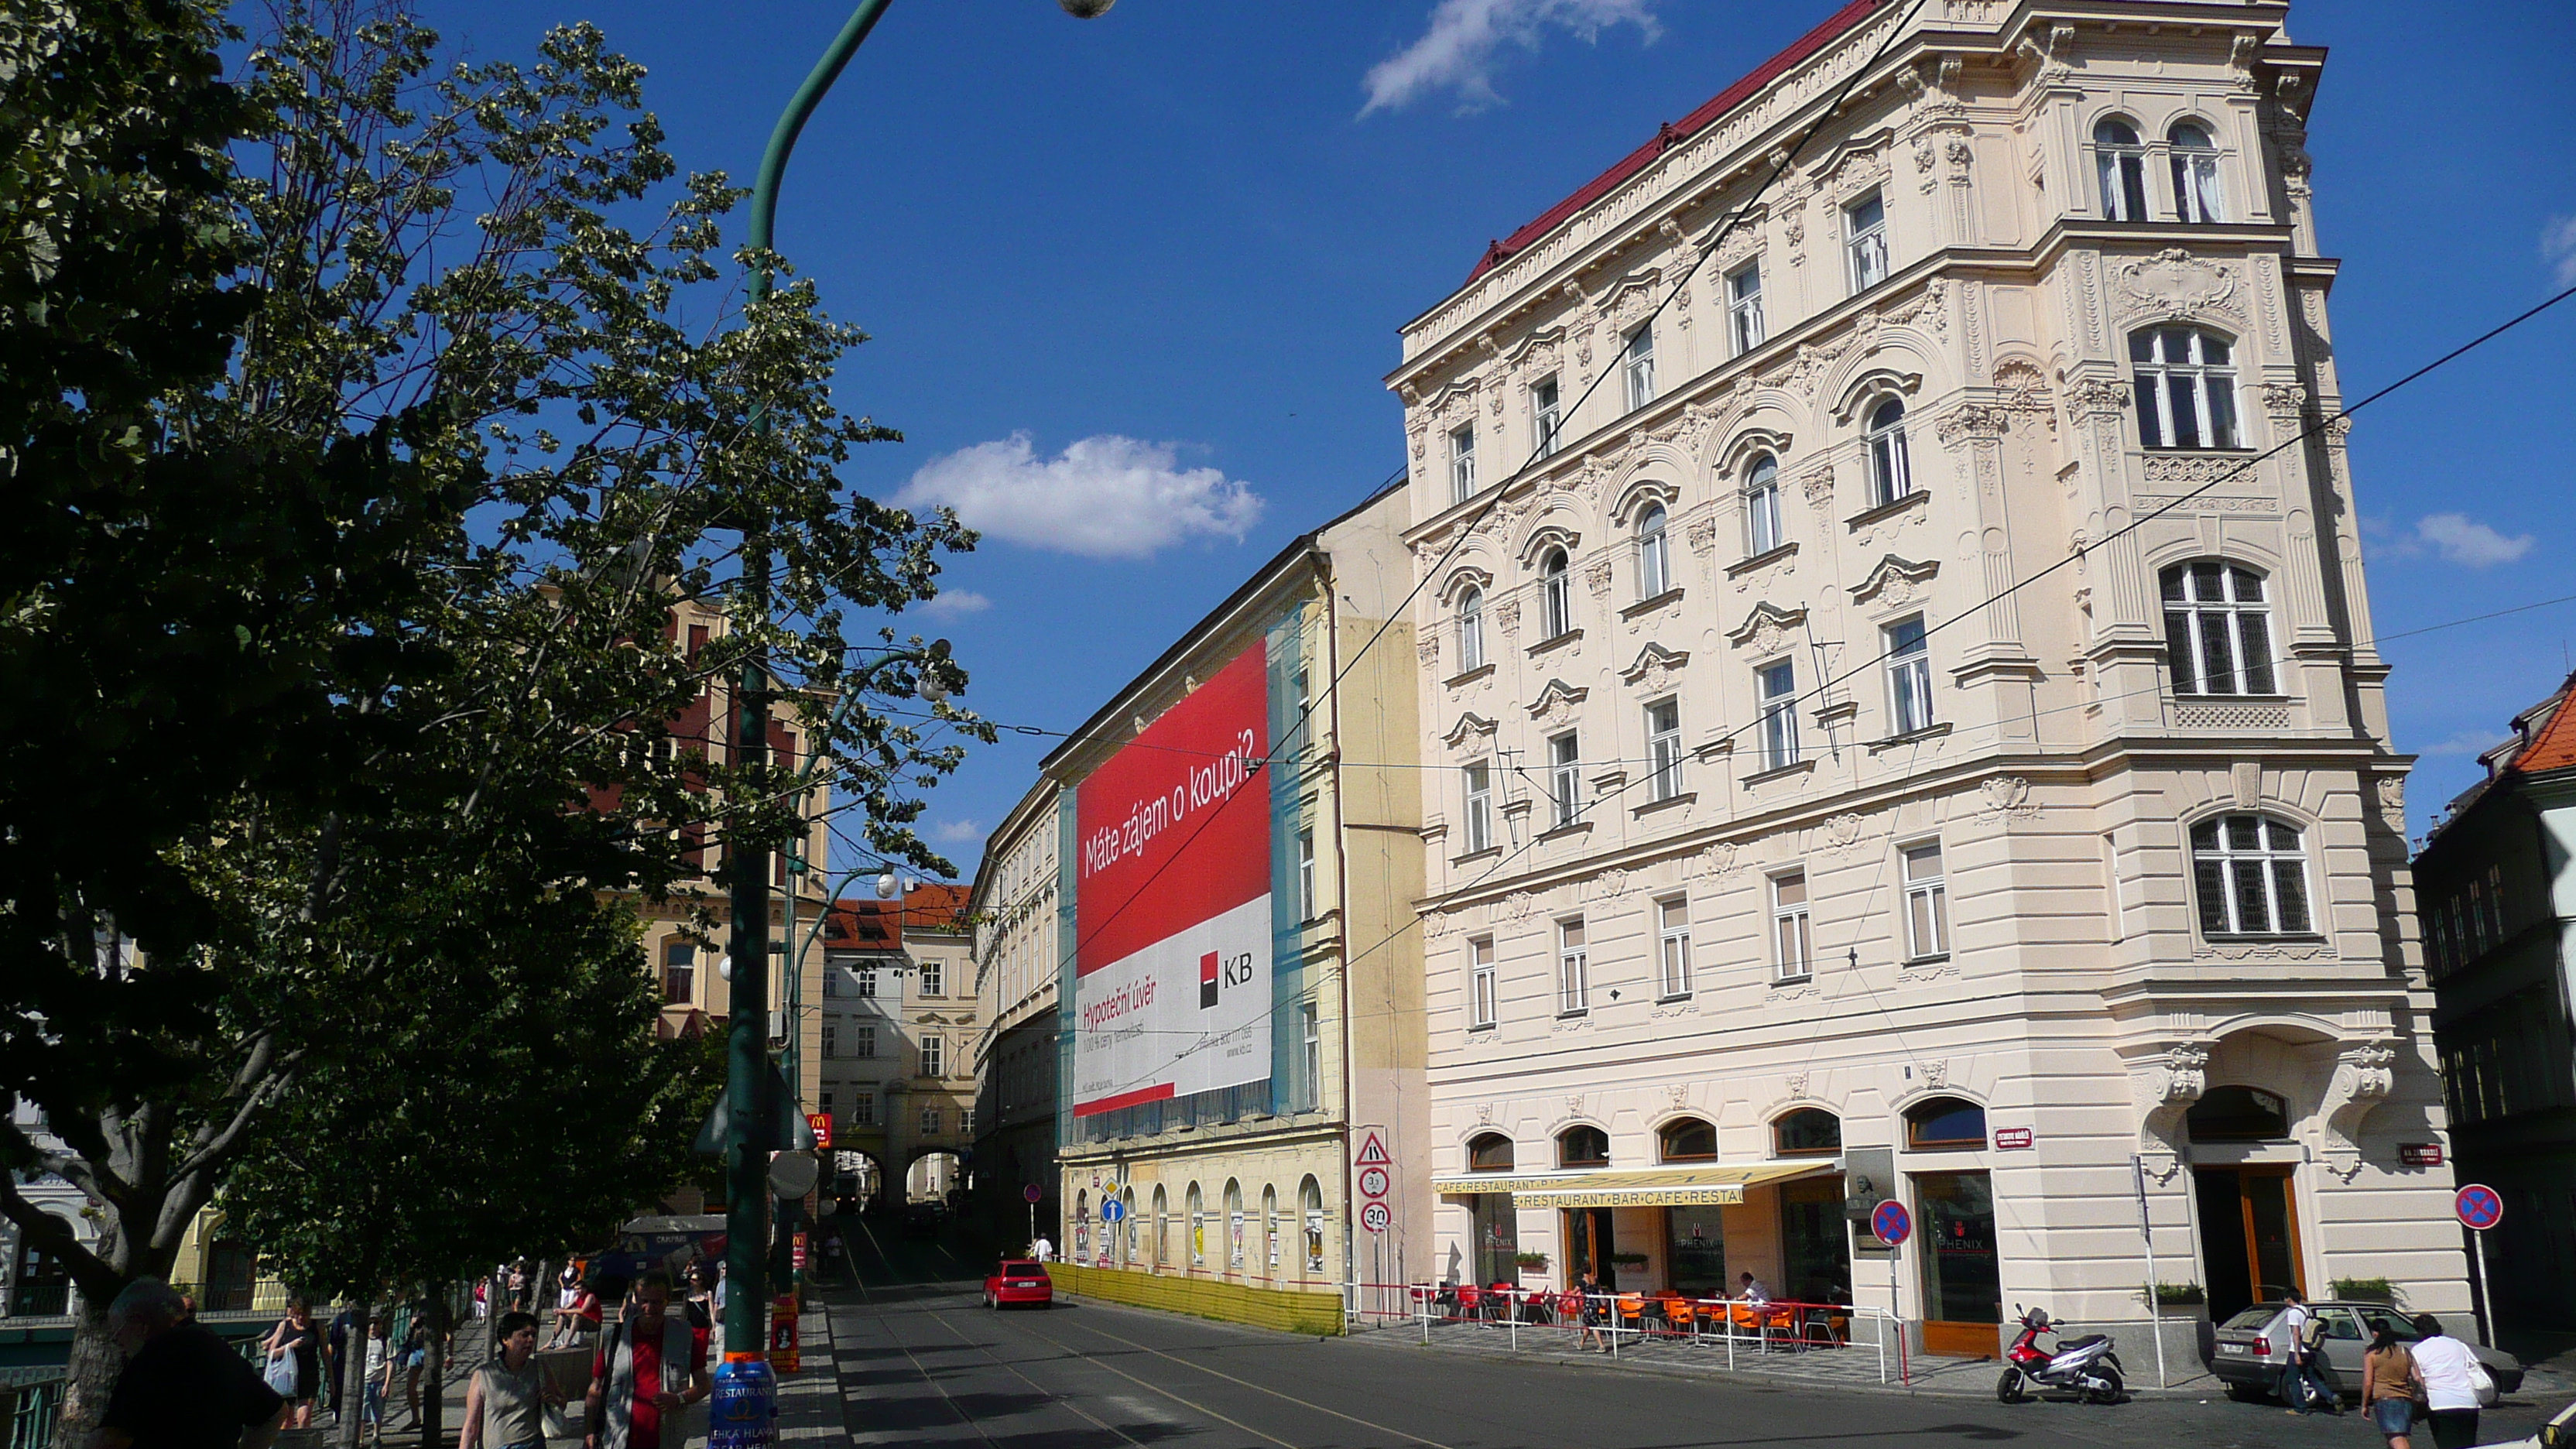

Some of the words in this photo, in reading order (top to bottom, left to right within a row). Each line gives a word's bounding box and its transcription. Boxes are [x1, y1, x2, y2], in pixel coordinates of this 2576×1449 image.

[1085, 827, 1119, 879] Máte
[1122, 800, 1167, 857] zájem
[1173, 785, 1184, 821] o
[1190, 728, 1254, 812] koupi?
[1224, 952, 1252, 989] KB
[1084, 982, 1131, 1033] Hypoteční
[1132, 974, 1156, 1010] úvěr
[1436, 1182, 1462, 1193] CAFE
[1466, 1180, 1536, 1192] RESTAURANT
[1524, 1194, 1606, 1207] RESTAURANT
[1612, 1193, 1639, 1205] BAR
[1645, 1192, 1683, 1204] CAFE
[1366, 1209, 1386, 1225] 30
[1680, 1238, 1714, 1249] PHENIX
[1938, 1239, 1983, 1249] PHENIX
[715, 1387, 772, 1399] RESTAURANT
[711, 1428, 740, 1440] LEHKÁ
[744, 1427, 774, 1438] HLAVA
